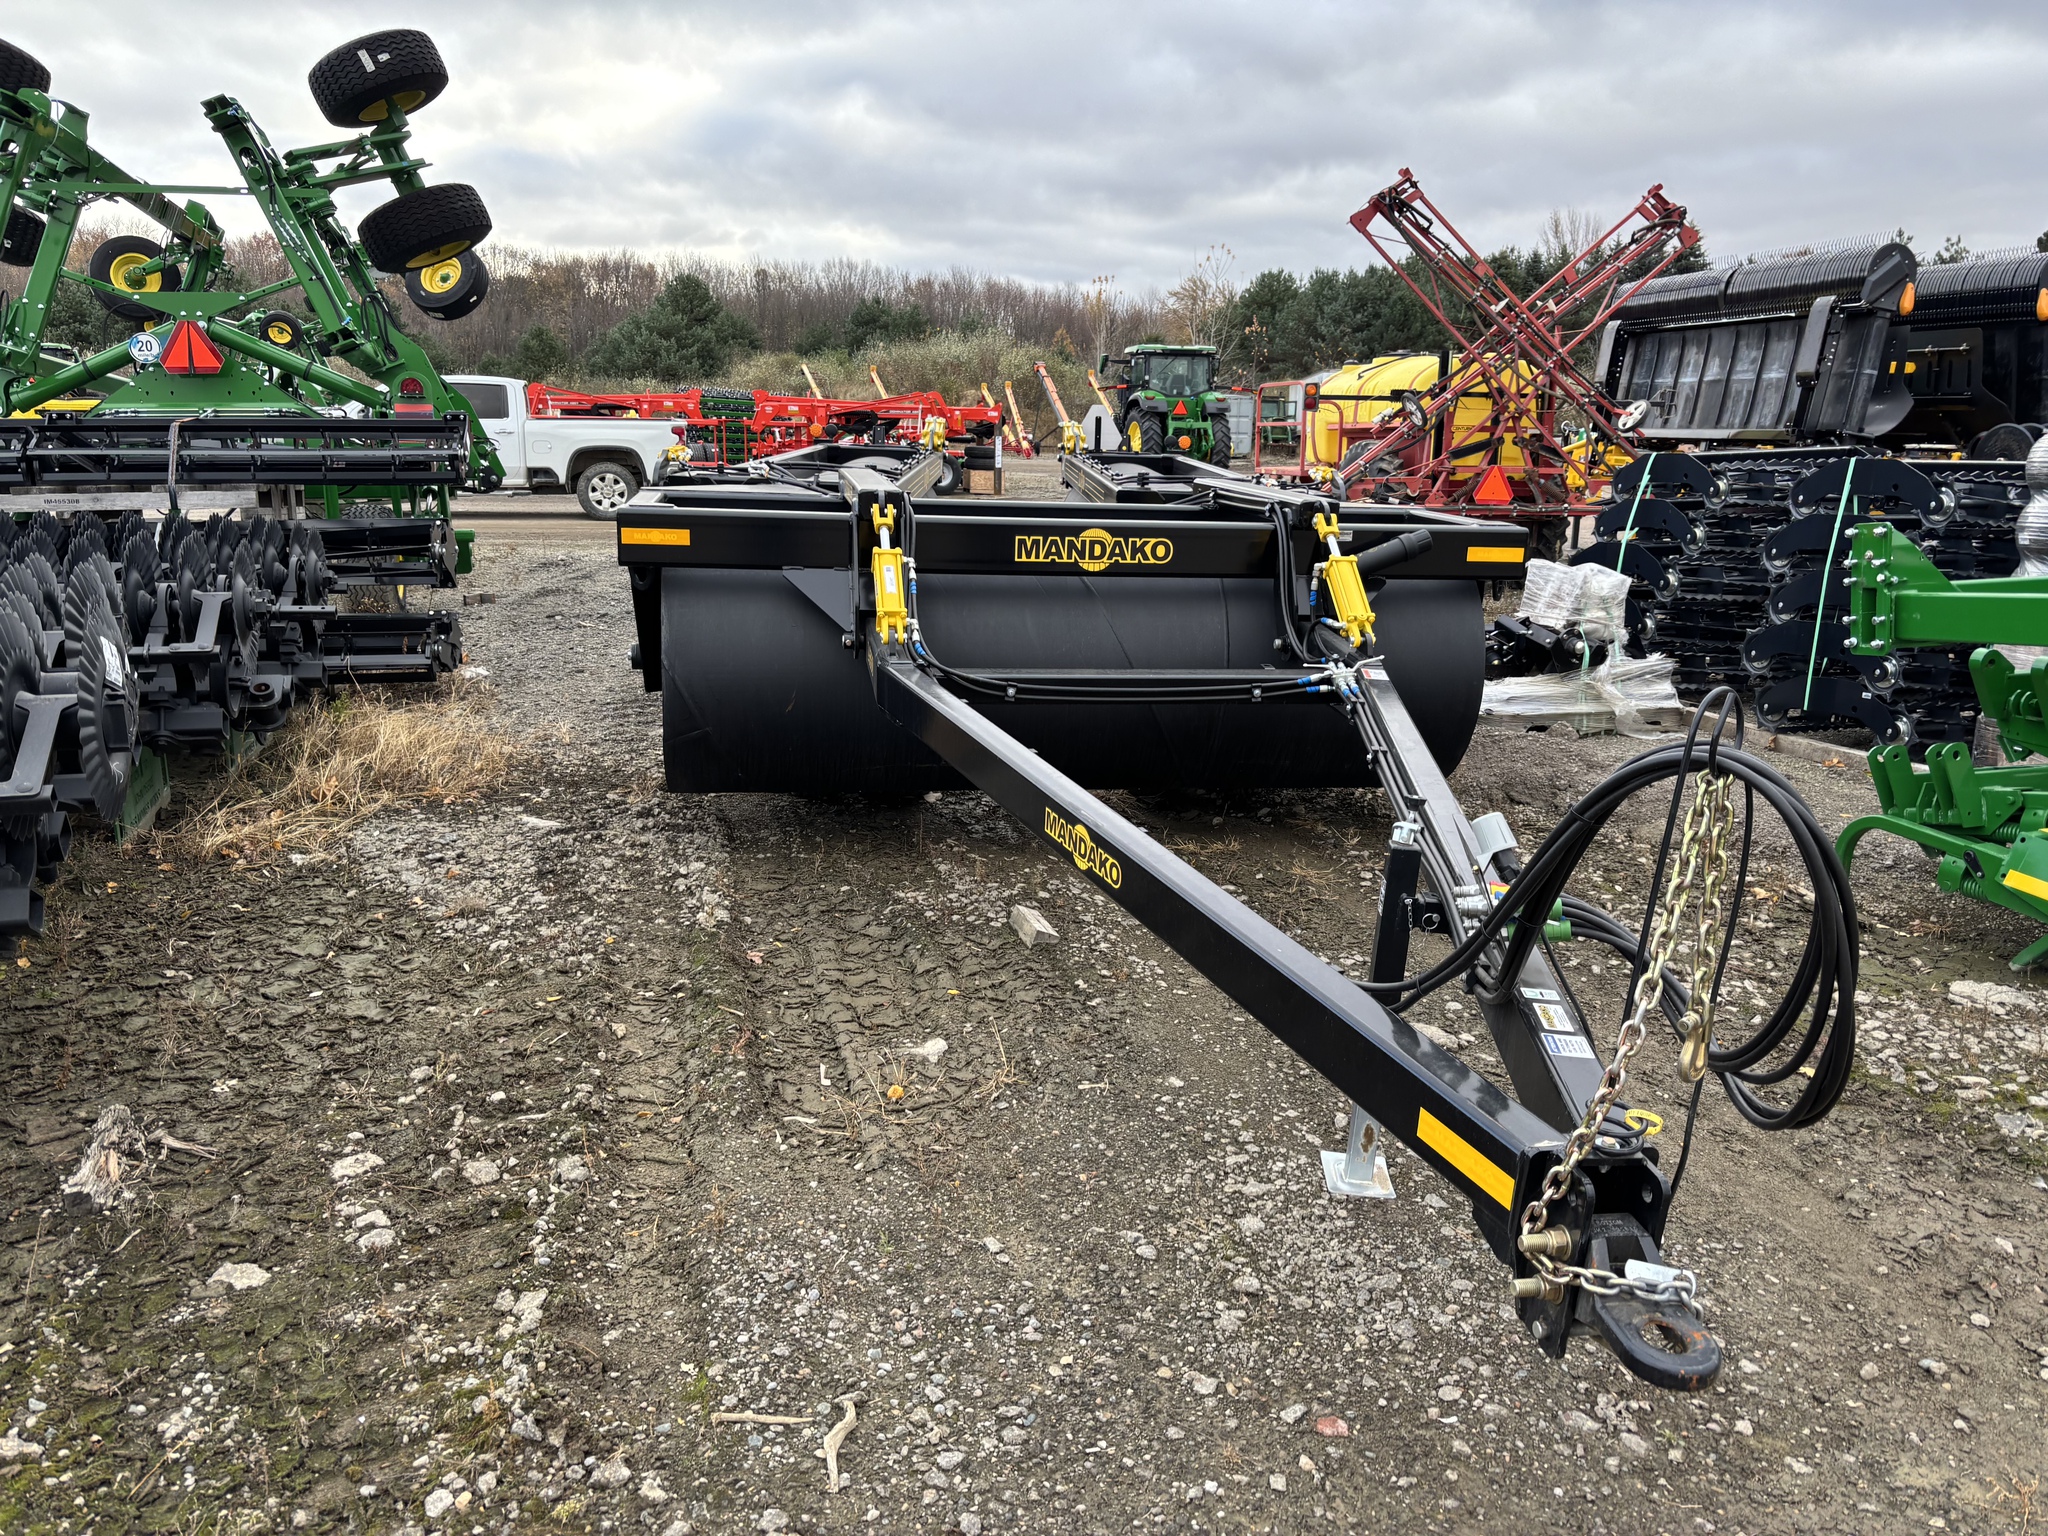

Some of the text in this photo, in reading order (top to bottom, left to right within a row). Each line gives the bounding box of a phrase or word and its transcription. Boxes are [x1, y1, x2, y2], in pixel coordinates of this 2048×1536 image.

[137, 340, 153, 352] 20
[1015, 535, 1173, 564] MANDAKO
[1044, 806, 1122, 889] MANDAKO
